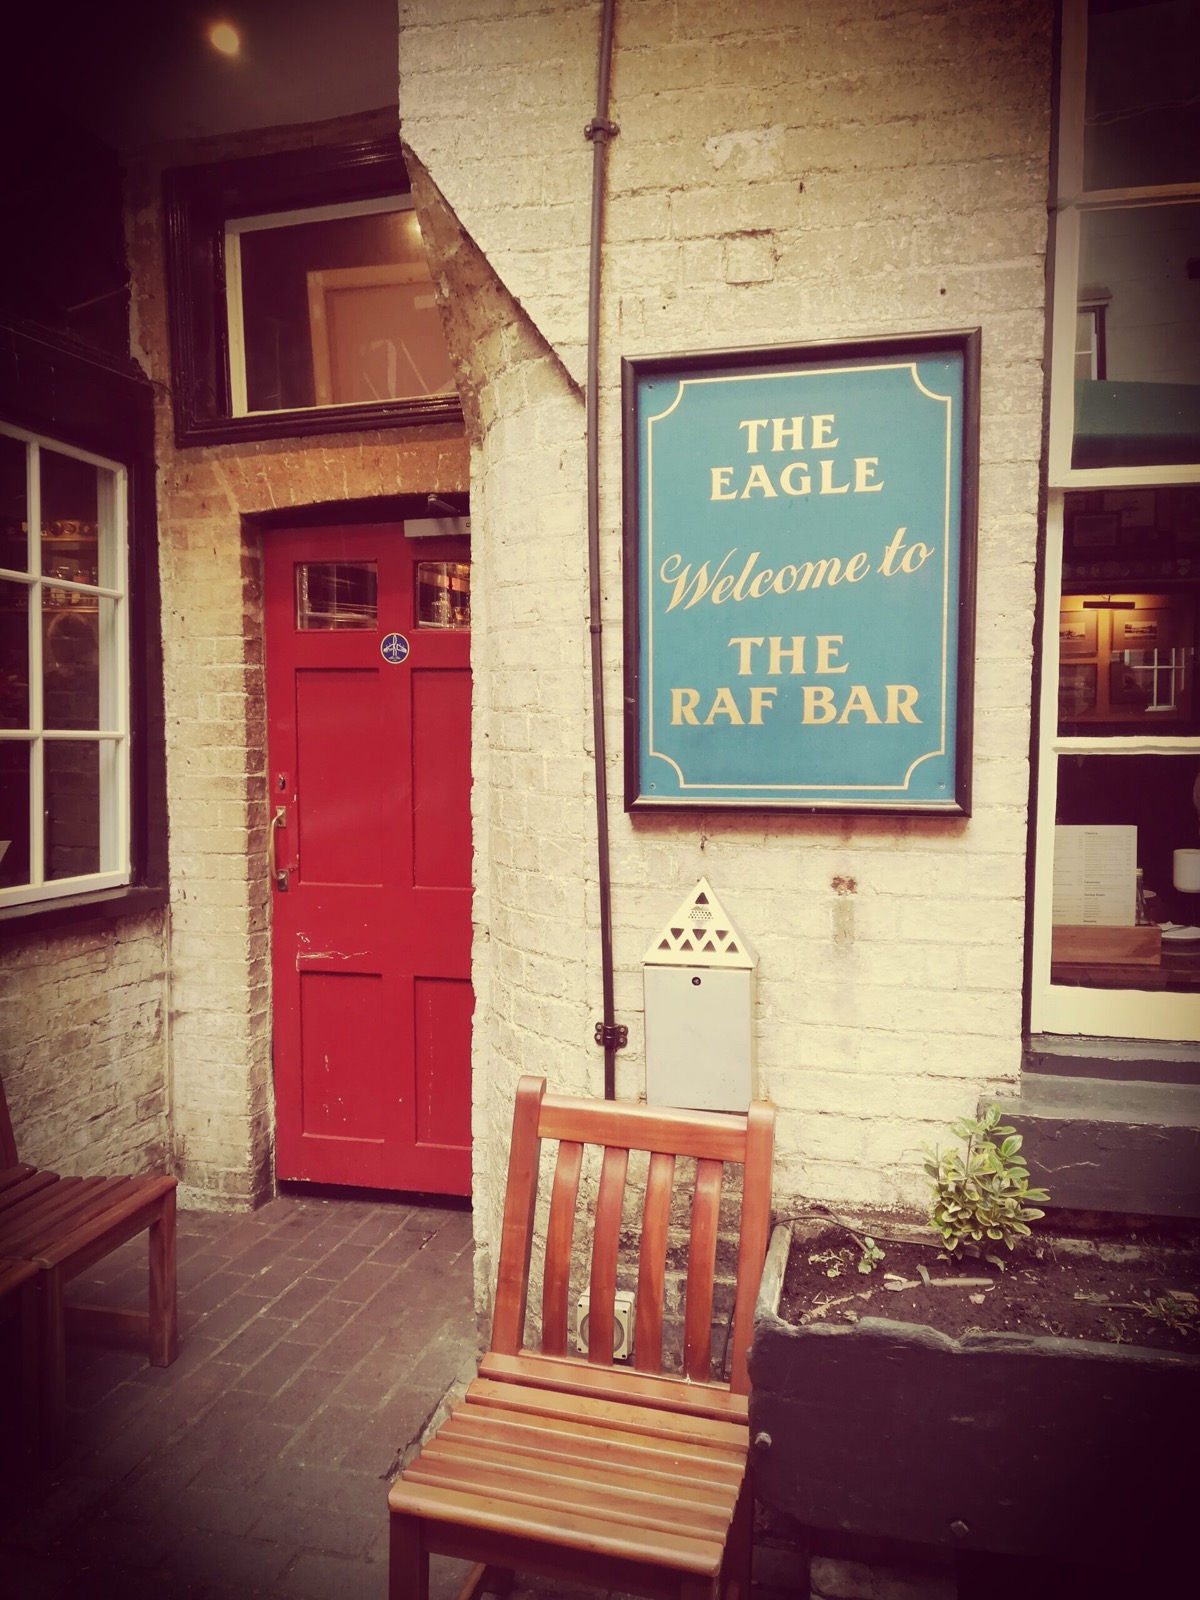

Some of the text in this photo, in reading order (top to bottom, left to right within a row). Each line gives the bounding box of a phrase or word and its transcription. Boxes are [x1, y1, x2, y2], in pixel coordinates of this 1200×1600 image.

[739, 414, 839, 453] THE
[710, 457, 884, 501] EAGLE
[660, 527, 935, 613] Welcome to
[728, 635, 849, 675] THE
[670, 685, 923, 725] RAF BAR
